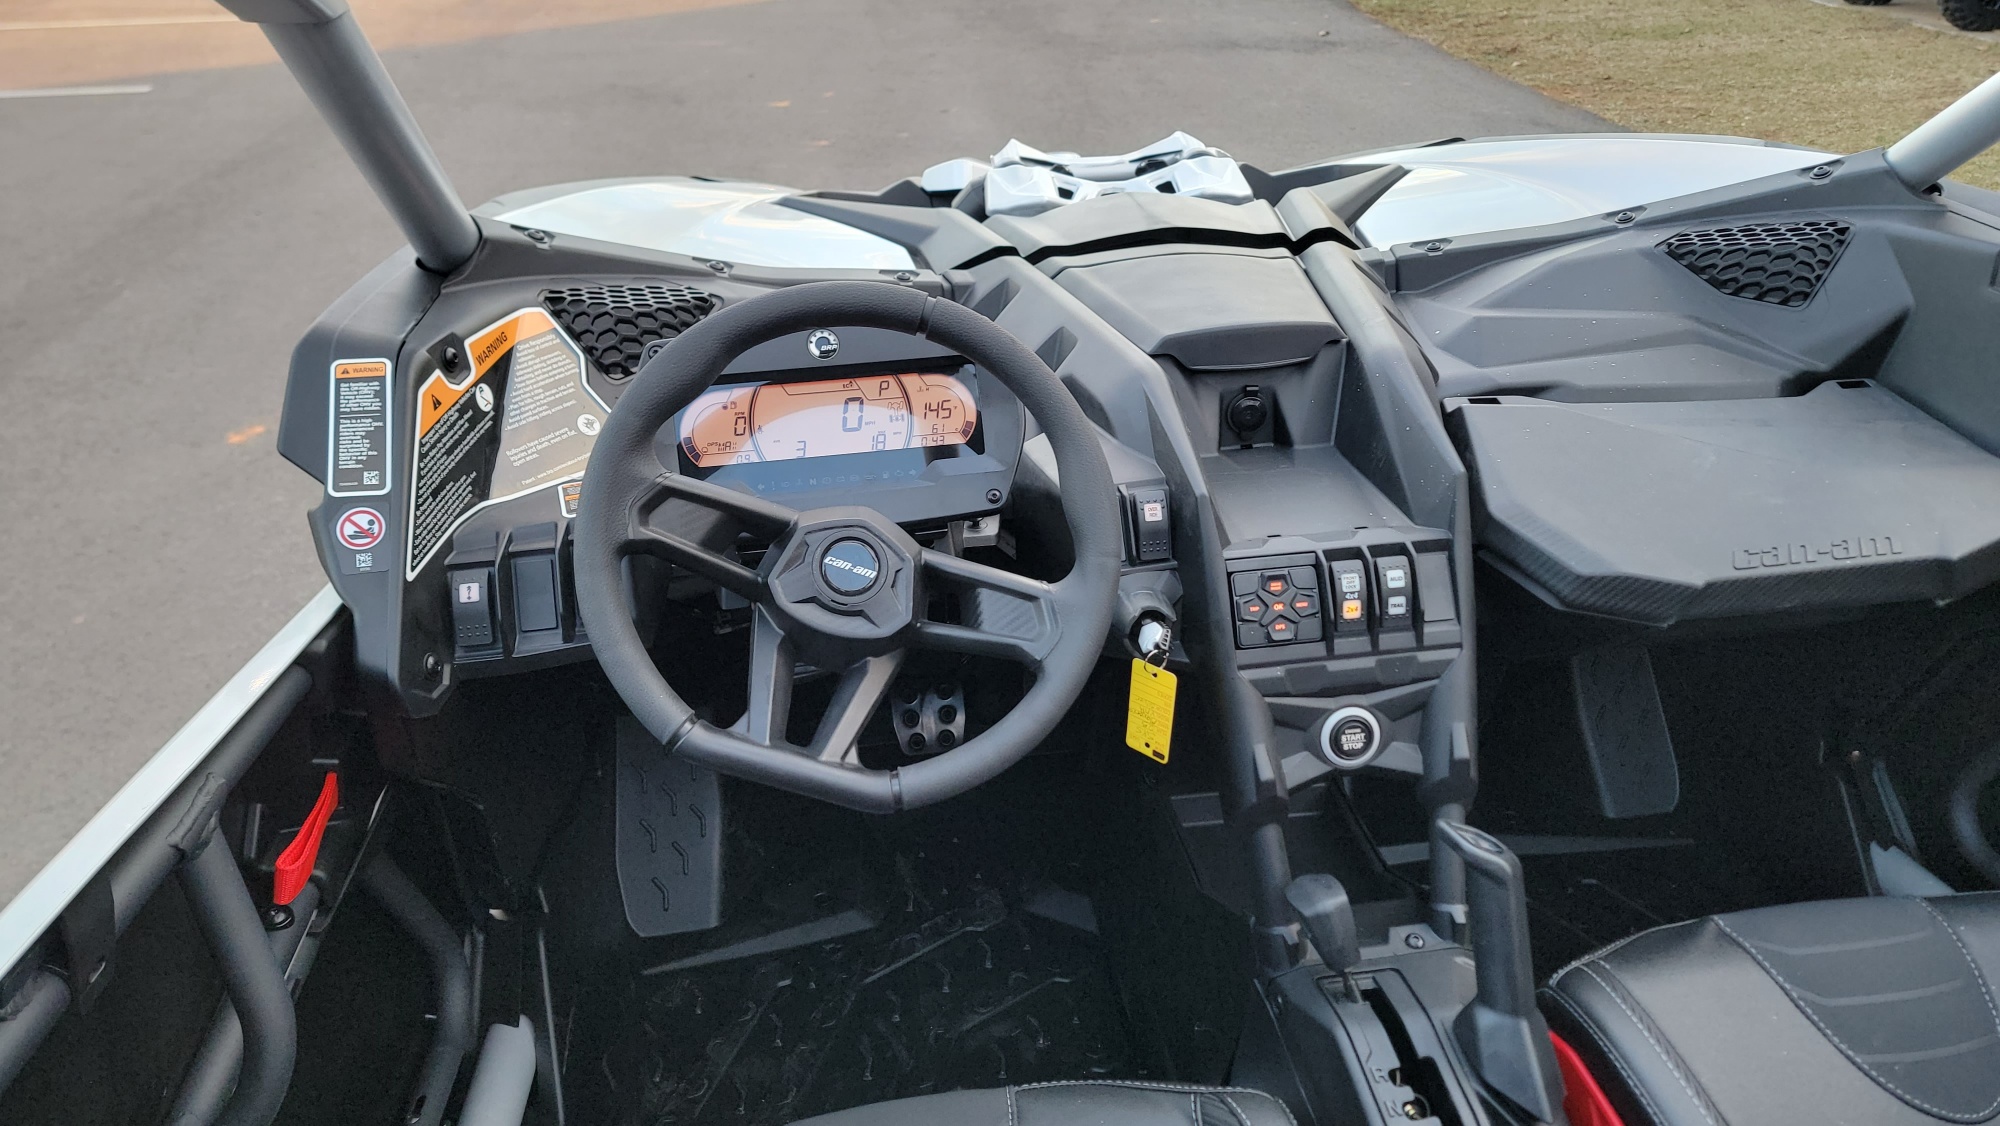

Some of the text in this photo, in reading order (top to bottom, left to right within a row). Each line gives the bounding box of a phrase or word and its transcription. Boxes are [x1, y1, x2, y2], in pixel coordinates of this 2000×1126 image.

[476, 332, 508, 366] WARNING
[879, 380, 890, 397] P
[842, 397, 864, 433] 0
[924, 400, 952, 420] 145
[734, 416, 746, 436] 0
[932, 424, 944, 433] 61
[796, 440, 806, 457] 3
[872, 434, 886, 450] 18
[1732, 536, 1902, 570] can-am
[824, 555, 877, 579] can-am
[1341, 733, 1366, 741] START
[1370, 1067, 1389, 1083] R
[1384, 1100, 1403, 1118] N
